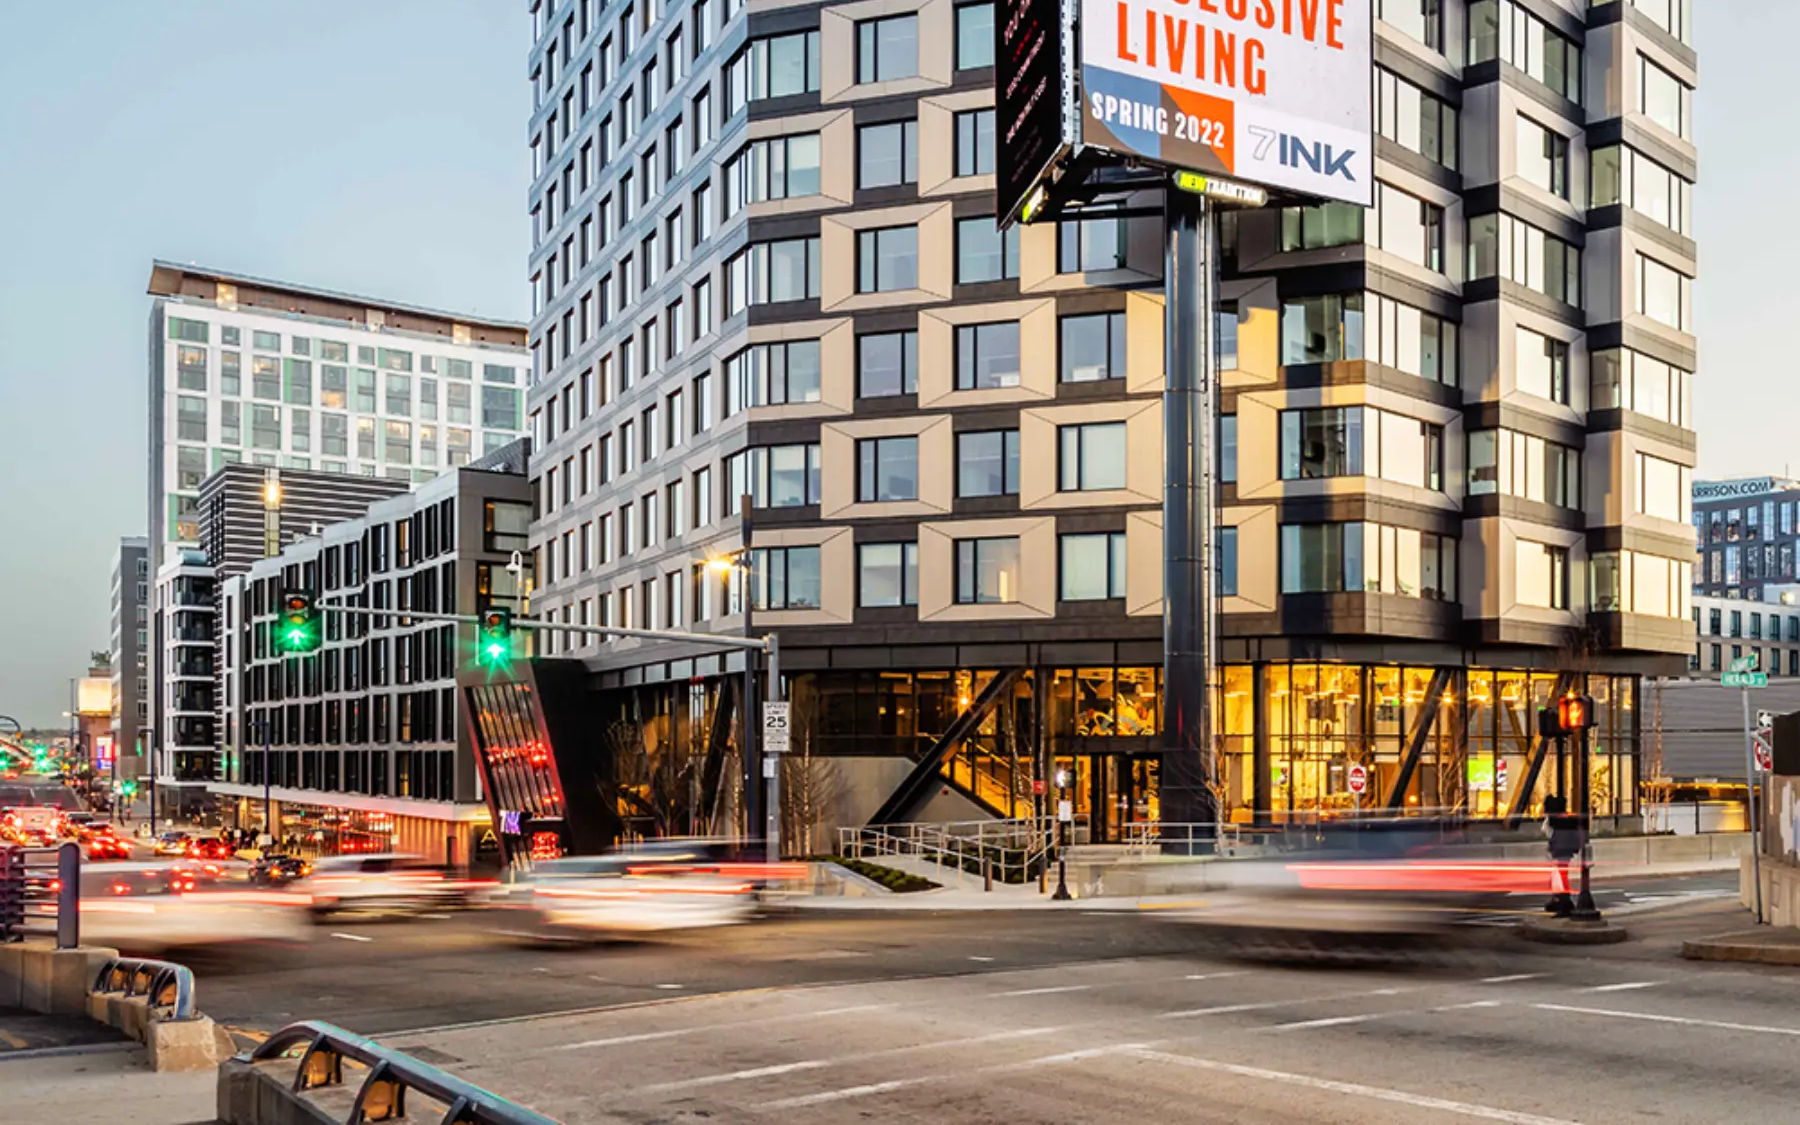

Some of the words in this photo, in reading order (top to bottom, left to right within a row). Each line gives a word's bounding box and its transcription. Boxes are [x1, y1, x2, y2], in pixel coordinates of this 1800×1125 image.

[1117, 1, 1266, 97] LIVING
[1092, 90, 1168, 136] SPRING
[1174, 112, 1225, 149] 2022
[1247, 124, 1357, 183] 7INK
[766, 716, 787, 728] 25
